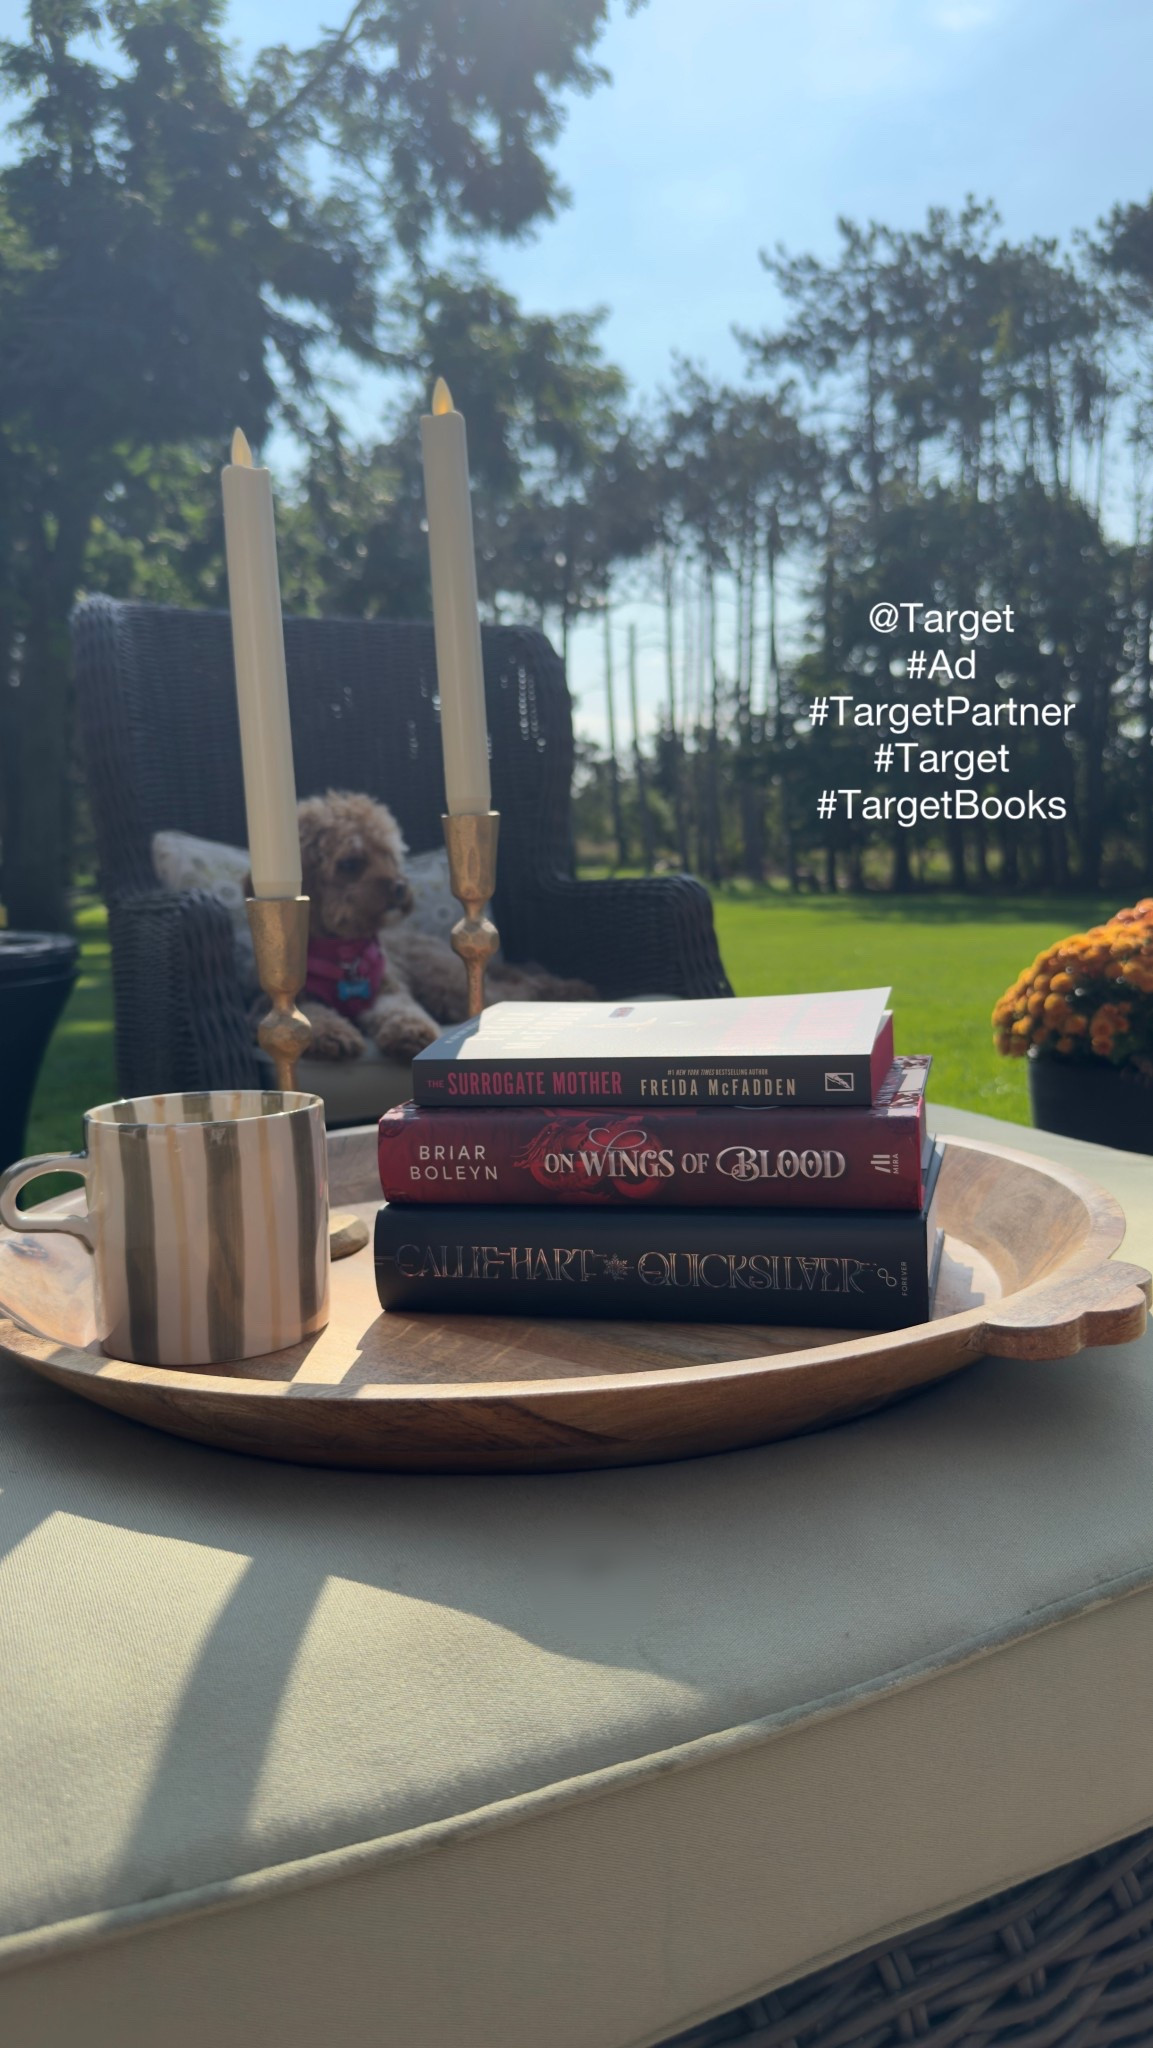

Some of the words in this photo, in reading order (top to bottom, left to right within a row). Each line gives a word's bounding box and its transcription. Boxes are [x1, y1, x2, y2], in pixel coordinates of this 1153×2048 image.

[427, 1080, 445, 1088] THE
[448, 1072, 545, 1095] SURROGATE
[553, 1071, 622, 1094] MOTHER
[640, 1079, 699, 1096] FREIDA
[708, 1078, 796, 1096] McFADDEN
[419, 1145, 486, 1160] BRIAR
[545, 1153, 574, 1174] ON
[578, 1128, 675, 1177] WINGS
[681, 1153, 710, 1174] OF
[716, 1146, 846, 1181] BLOOD
[410, 1166, 498, 1180] BOLEYN
[395, 1244, 500, 1279] CALLIE
[509, 1247, 598, 1282] HART
[637, 1251, 866, 1293] QUICKSILVER
